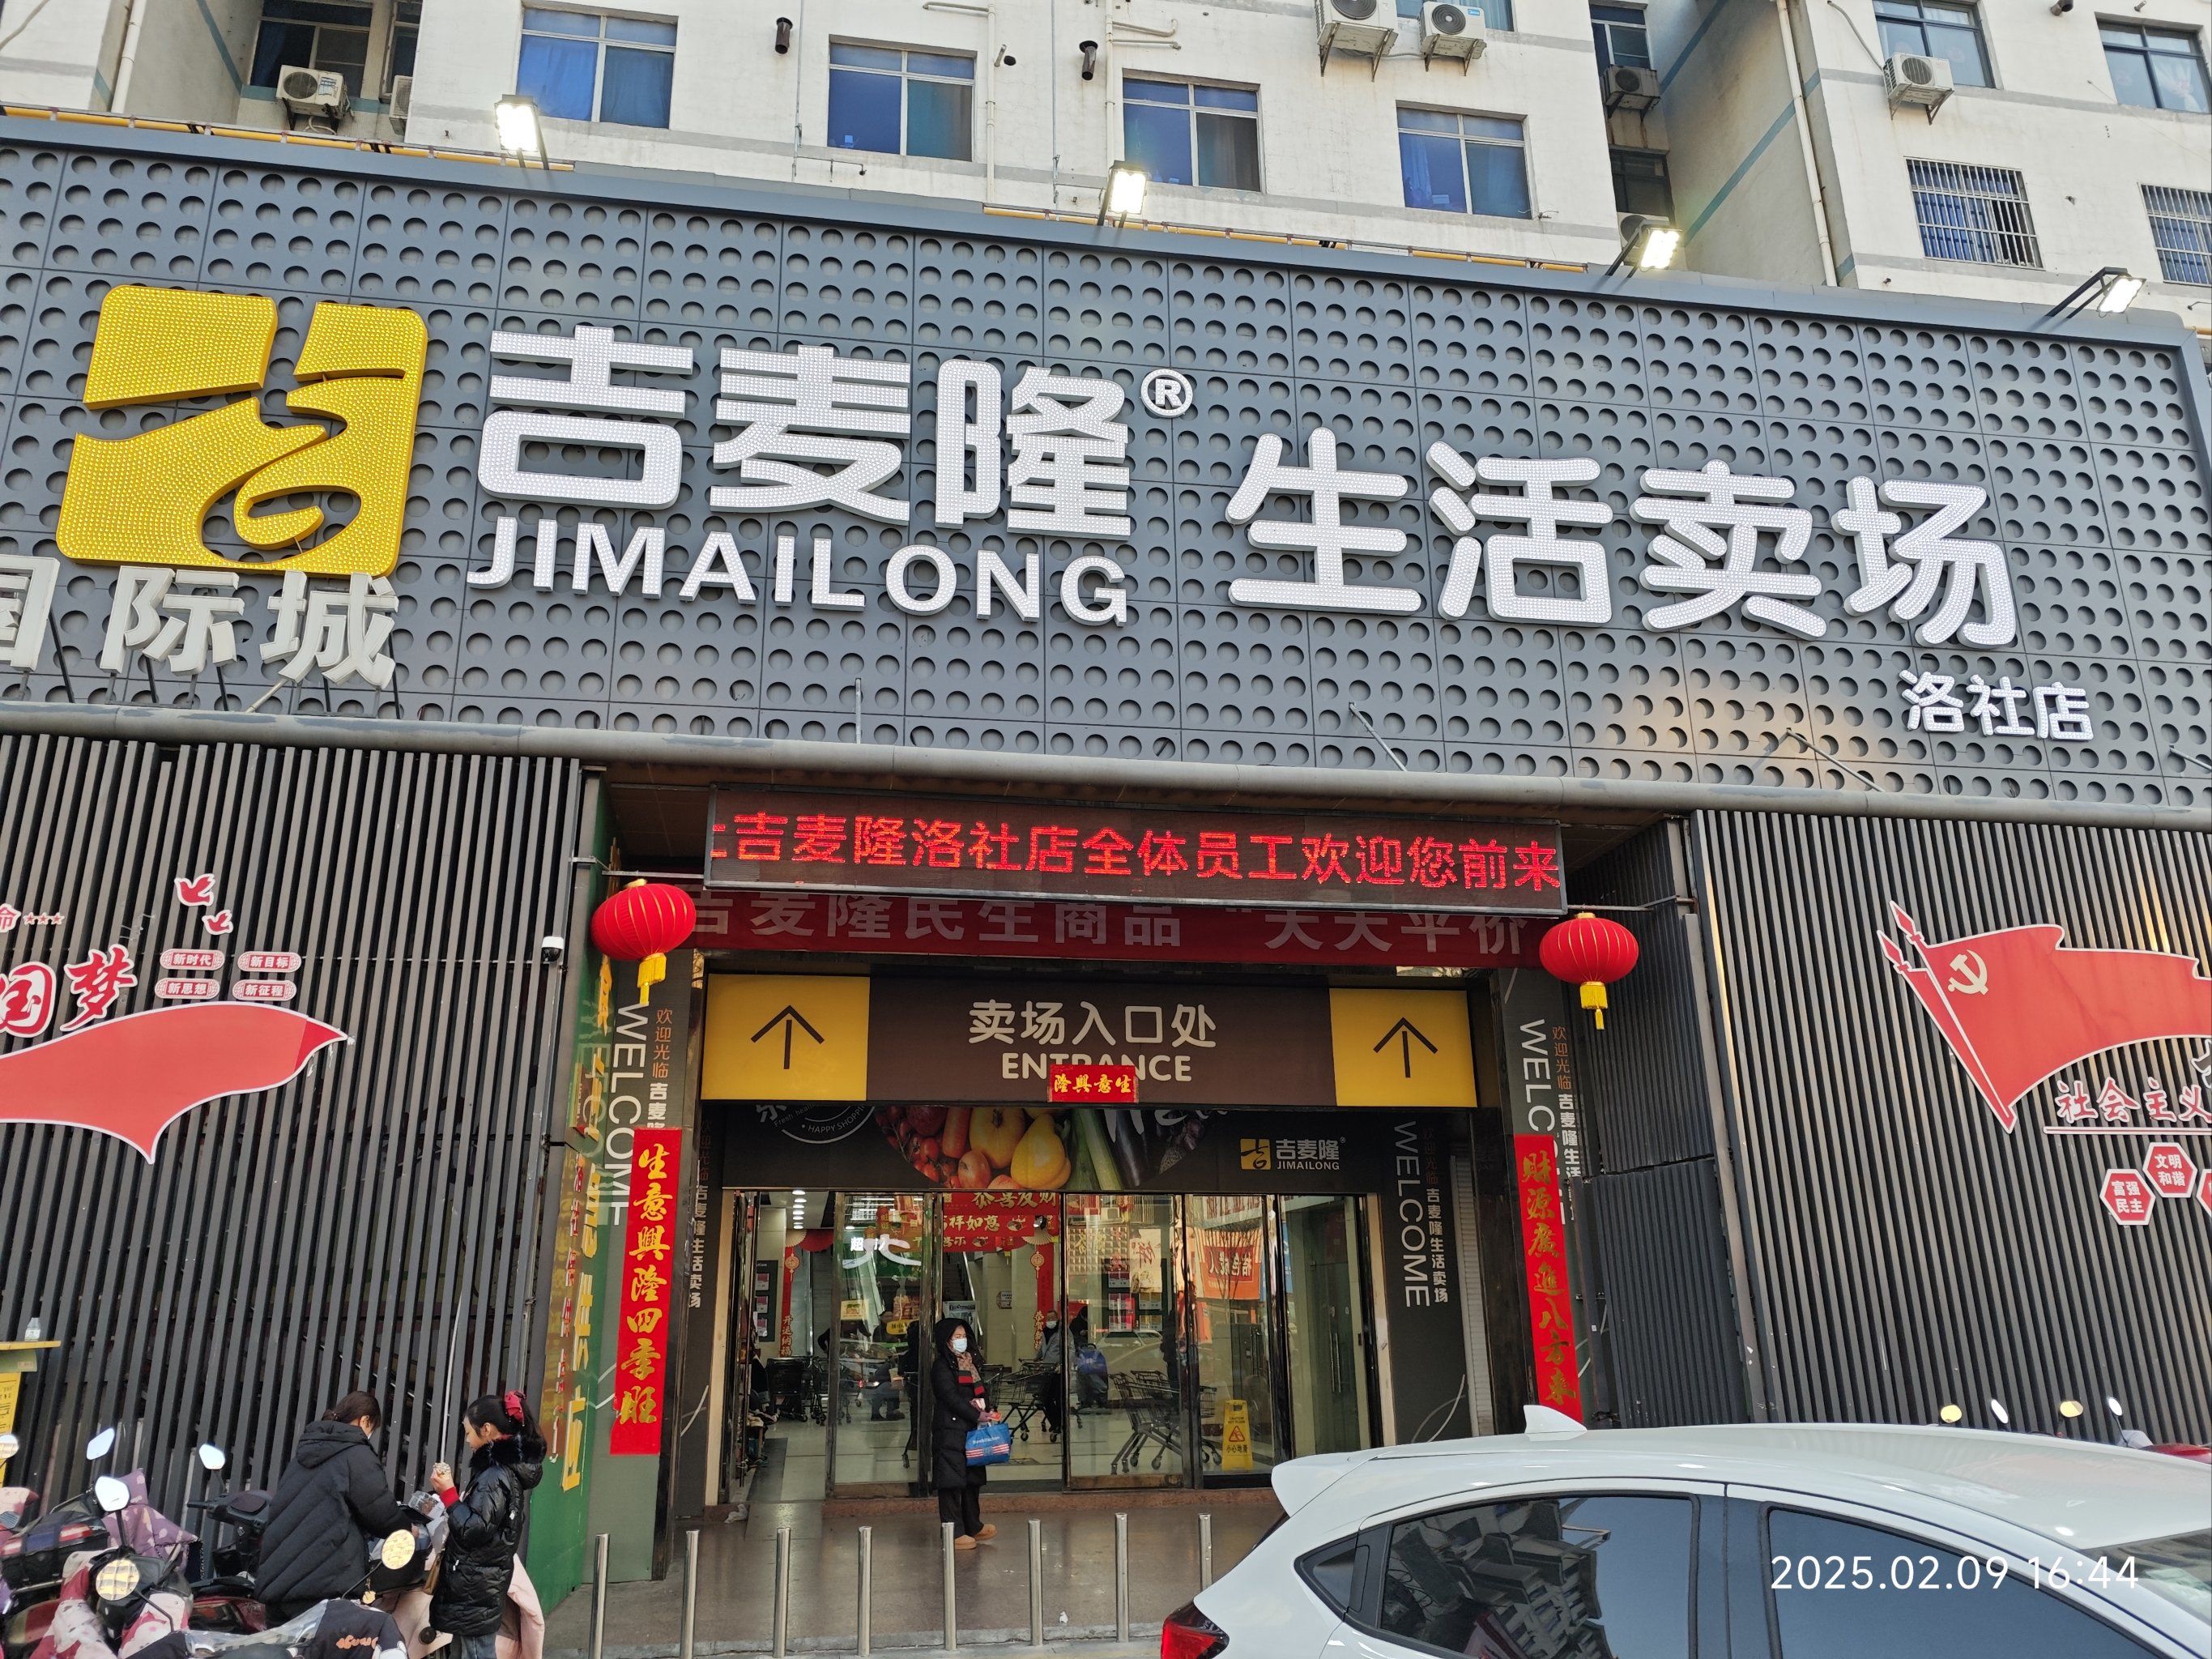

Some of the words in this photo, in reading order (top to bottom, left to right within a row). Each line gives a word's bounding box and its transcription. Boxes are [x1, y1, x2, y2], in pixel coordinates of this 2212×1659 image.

[478, 325, 1132, 541] 吉麦隆
[1225, 426, 2018, 648] 生活卖场
[467, 516, 1128, 628] JIMAILONG
[1899, 669, 2094, 742] 洛社店
[710, 811, 1561, 891] 吉麦隆洛社店全体员工欢迎您前来
[173, 953, 212, 966] 新时代
[249, 955, 289, 968] 新目标
[168, 982, 207, 995] 新思想
[245, 984, 284, 996] 新征程
[968, 999, 1217, 1048] 卖场入口处
[2055, 1077, 2212, 1124] 社会主义
[808, 1124, 836, 1134] HAPPY
[1276, 1138, 1340, 1160] 吉麦隆
[1276, 1160, 1340, 1171] JIMAILONG
[2154, 1154, 2183, 1169] 文明
[2158, 1171, 2186, 1187] 和谐
[2111, 1180, 2141, 1196] 富强
[1393, 1120, 1430, 1307] WELCOME
[2115, 1198, 2145, 1213] 民主
